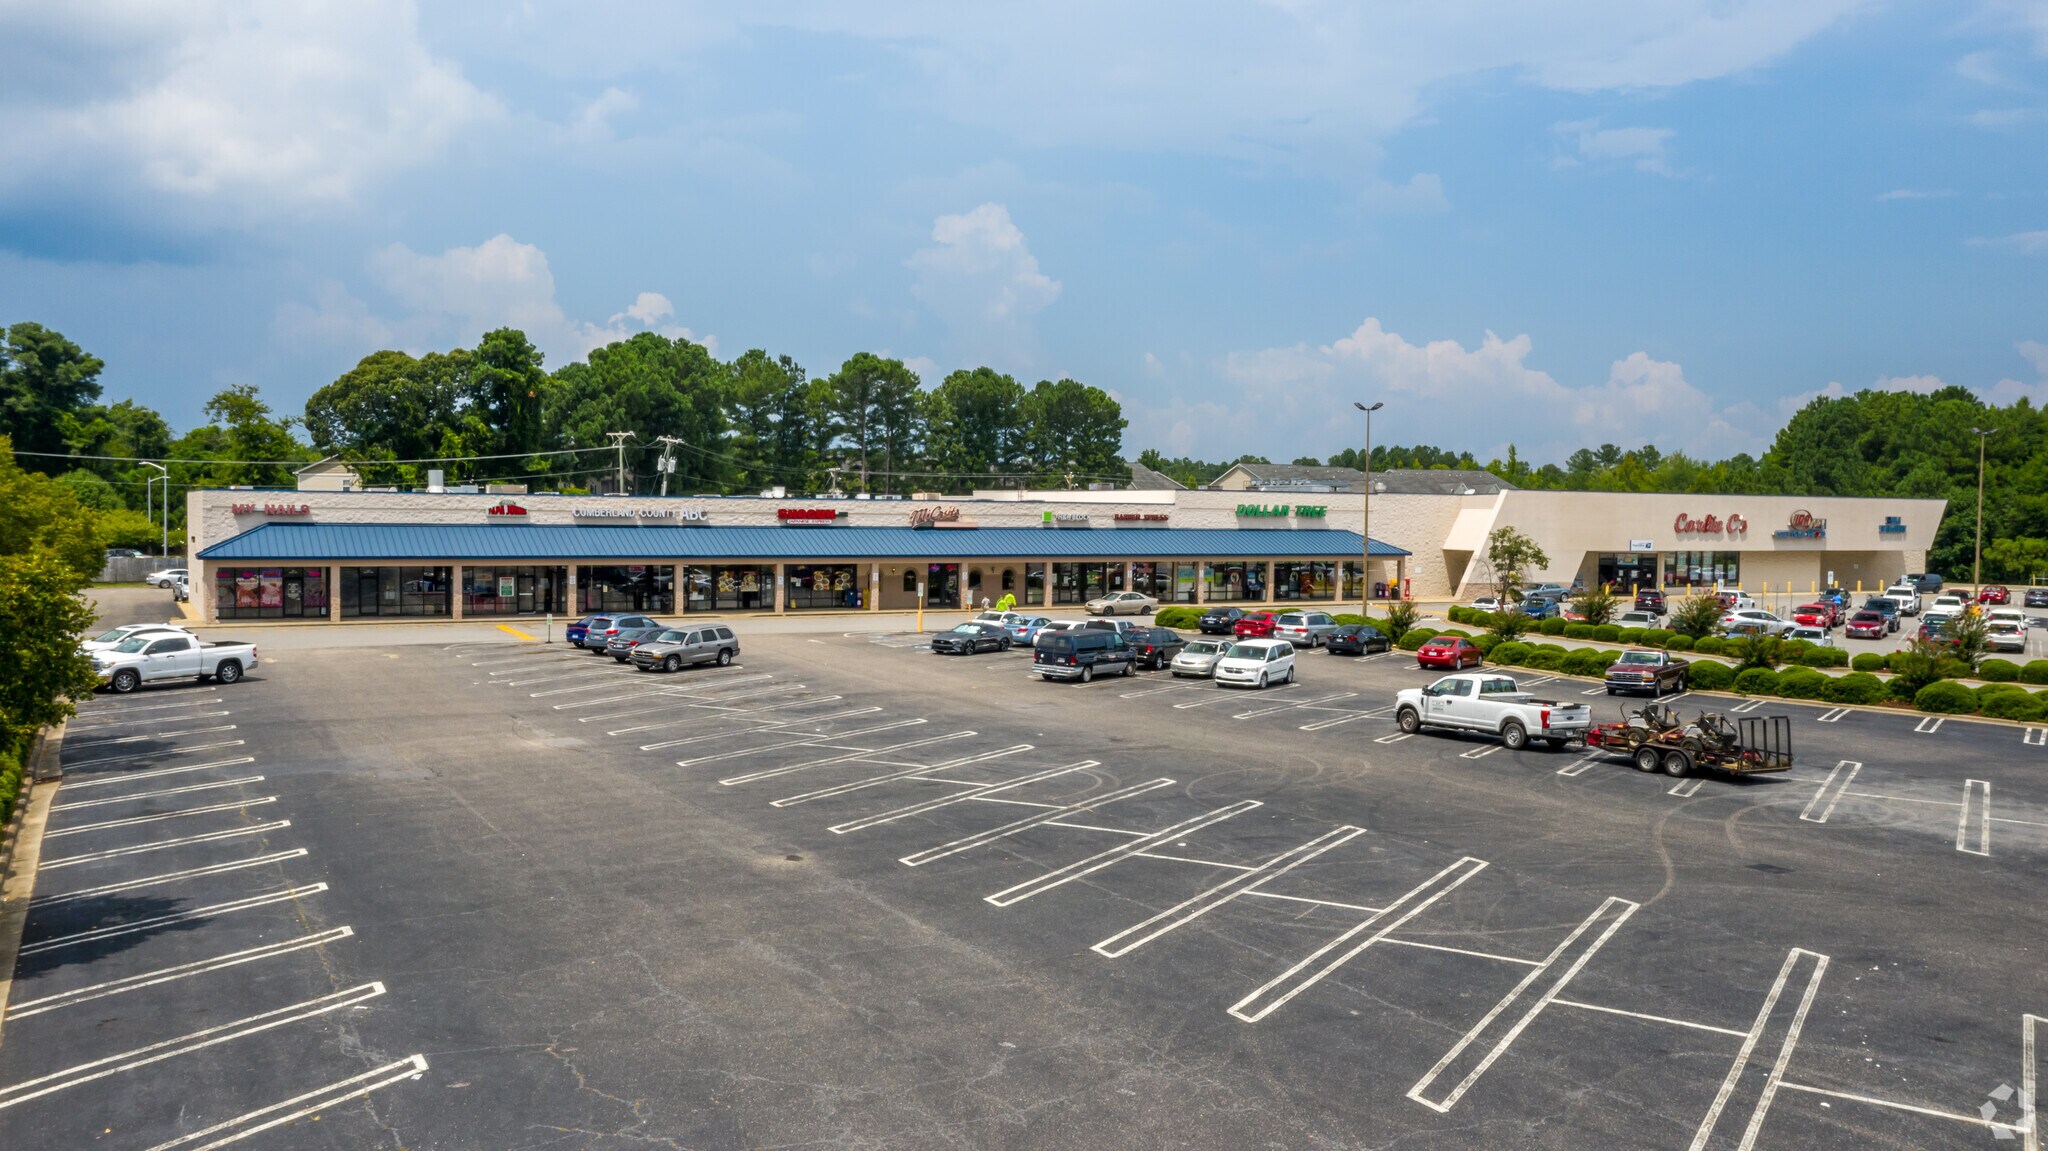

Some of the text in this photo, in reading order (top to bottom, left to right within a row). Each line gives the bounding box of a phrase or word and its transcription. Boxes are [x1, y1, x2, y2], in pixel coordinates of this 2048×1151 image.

[231, 503, 311, 516] MY NAILS
[572, 506, 708, 521] CUMBERLAND COUNTY ABC
[1235, 504, 1328, 518] DOLLAR TREE
